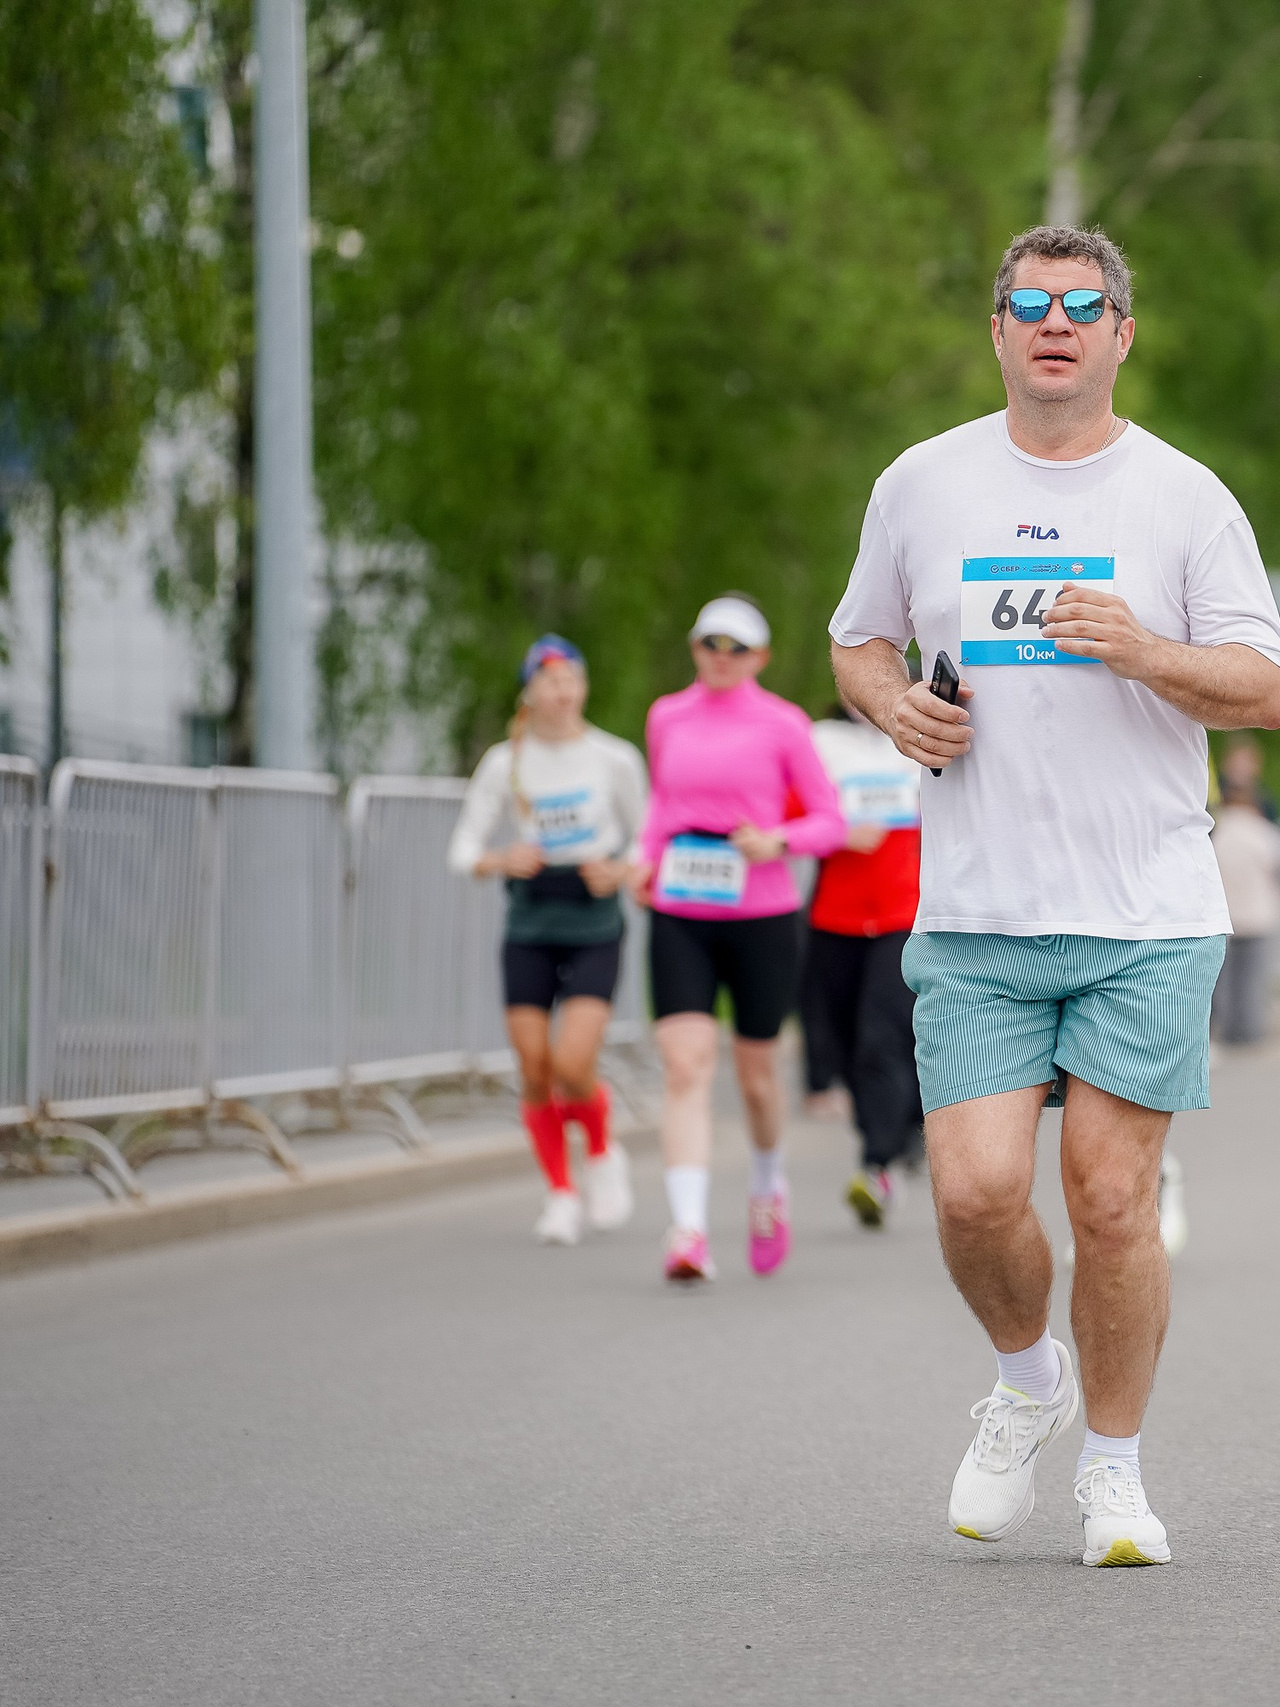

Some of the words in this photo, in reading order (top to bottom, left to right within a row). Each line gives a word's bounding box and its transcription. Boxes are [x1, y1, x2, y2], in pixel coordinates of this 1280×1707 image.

[1016, 524, 1060, 540] FILA
[1000, 565, 1020, 573] СБЕР
[991, 589, 1064, 631] 64
